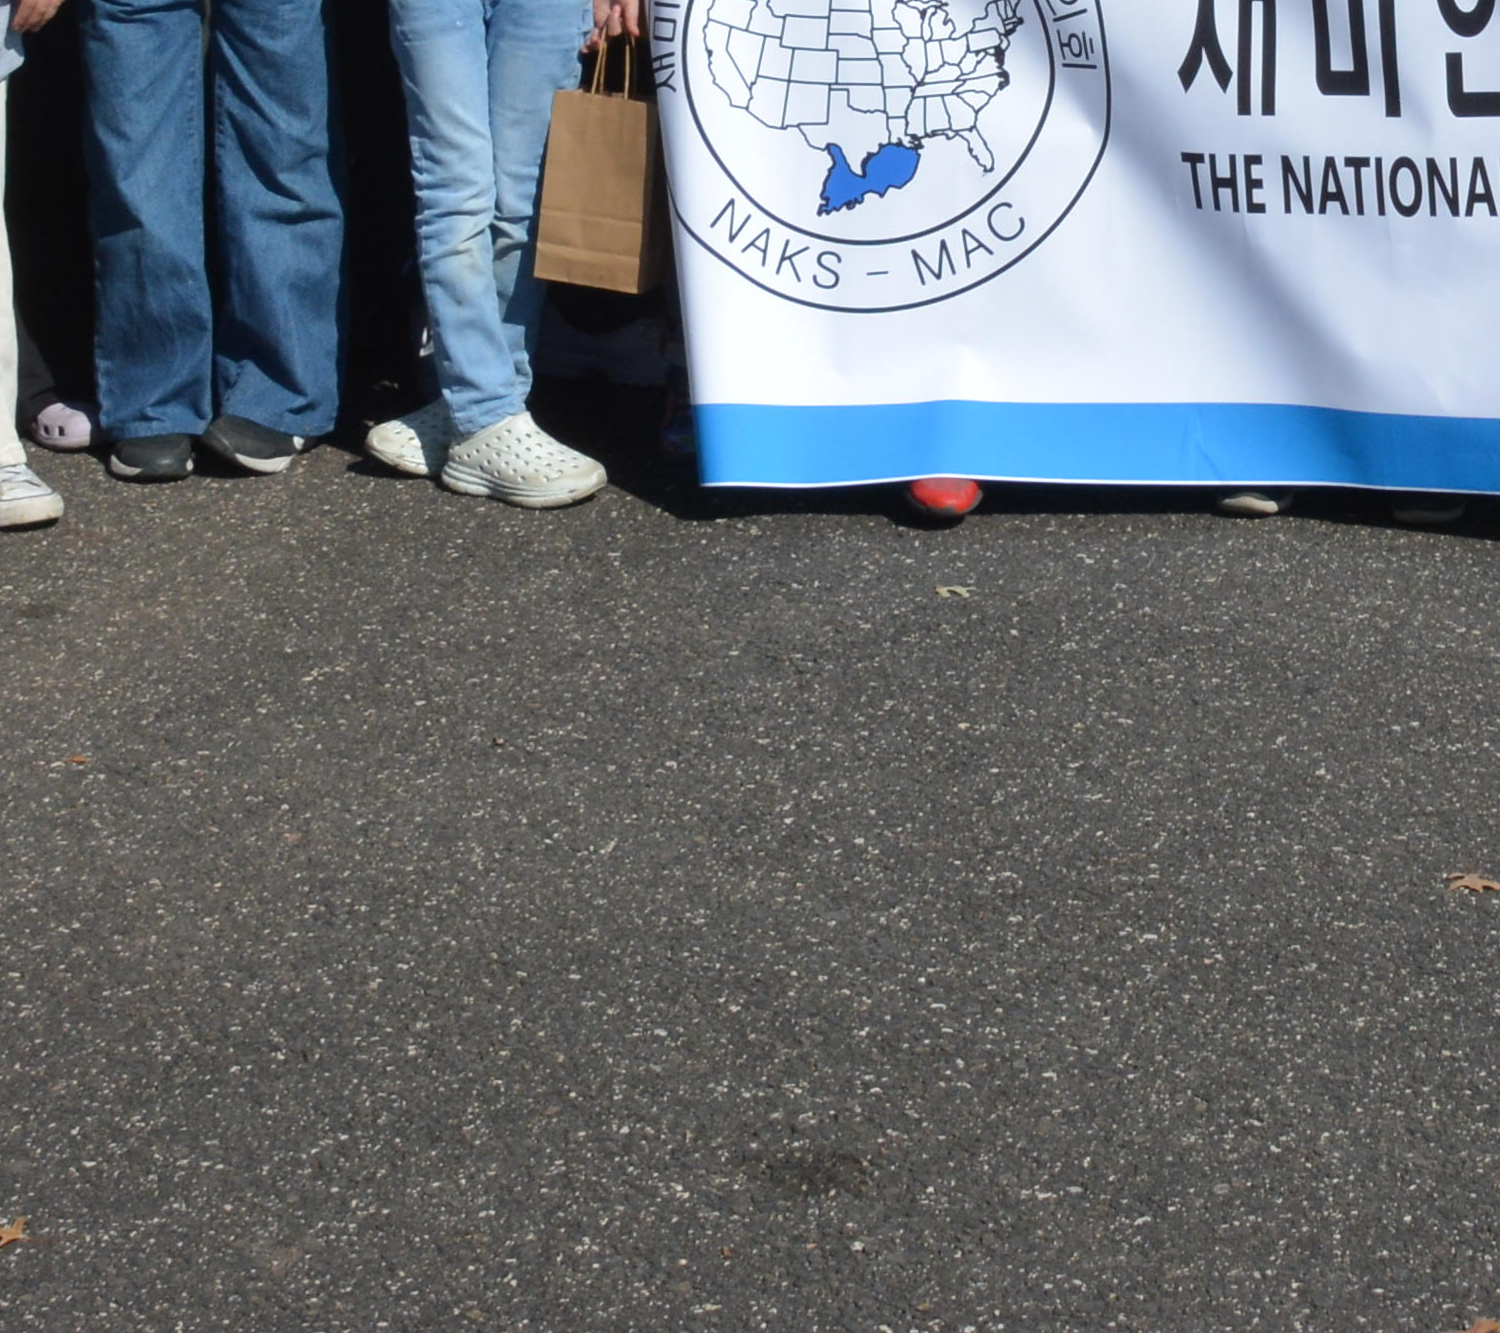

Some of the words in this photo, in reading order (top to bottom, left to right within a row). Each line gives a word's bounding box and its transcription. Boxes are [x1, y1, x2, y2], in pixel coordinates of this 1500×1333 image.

[1181, 151, 1267, 215] THE
[710, 198, 842, 290] NAKS
[911, 201, 1026, 286] MAC
